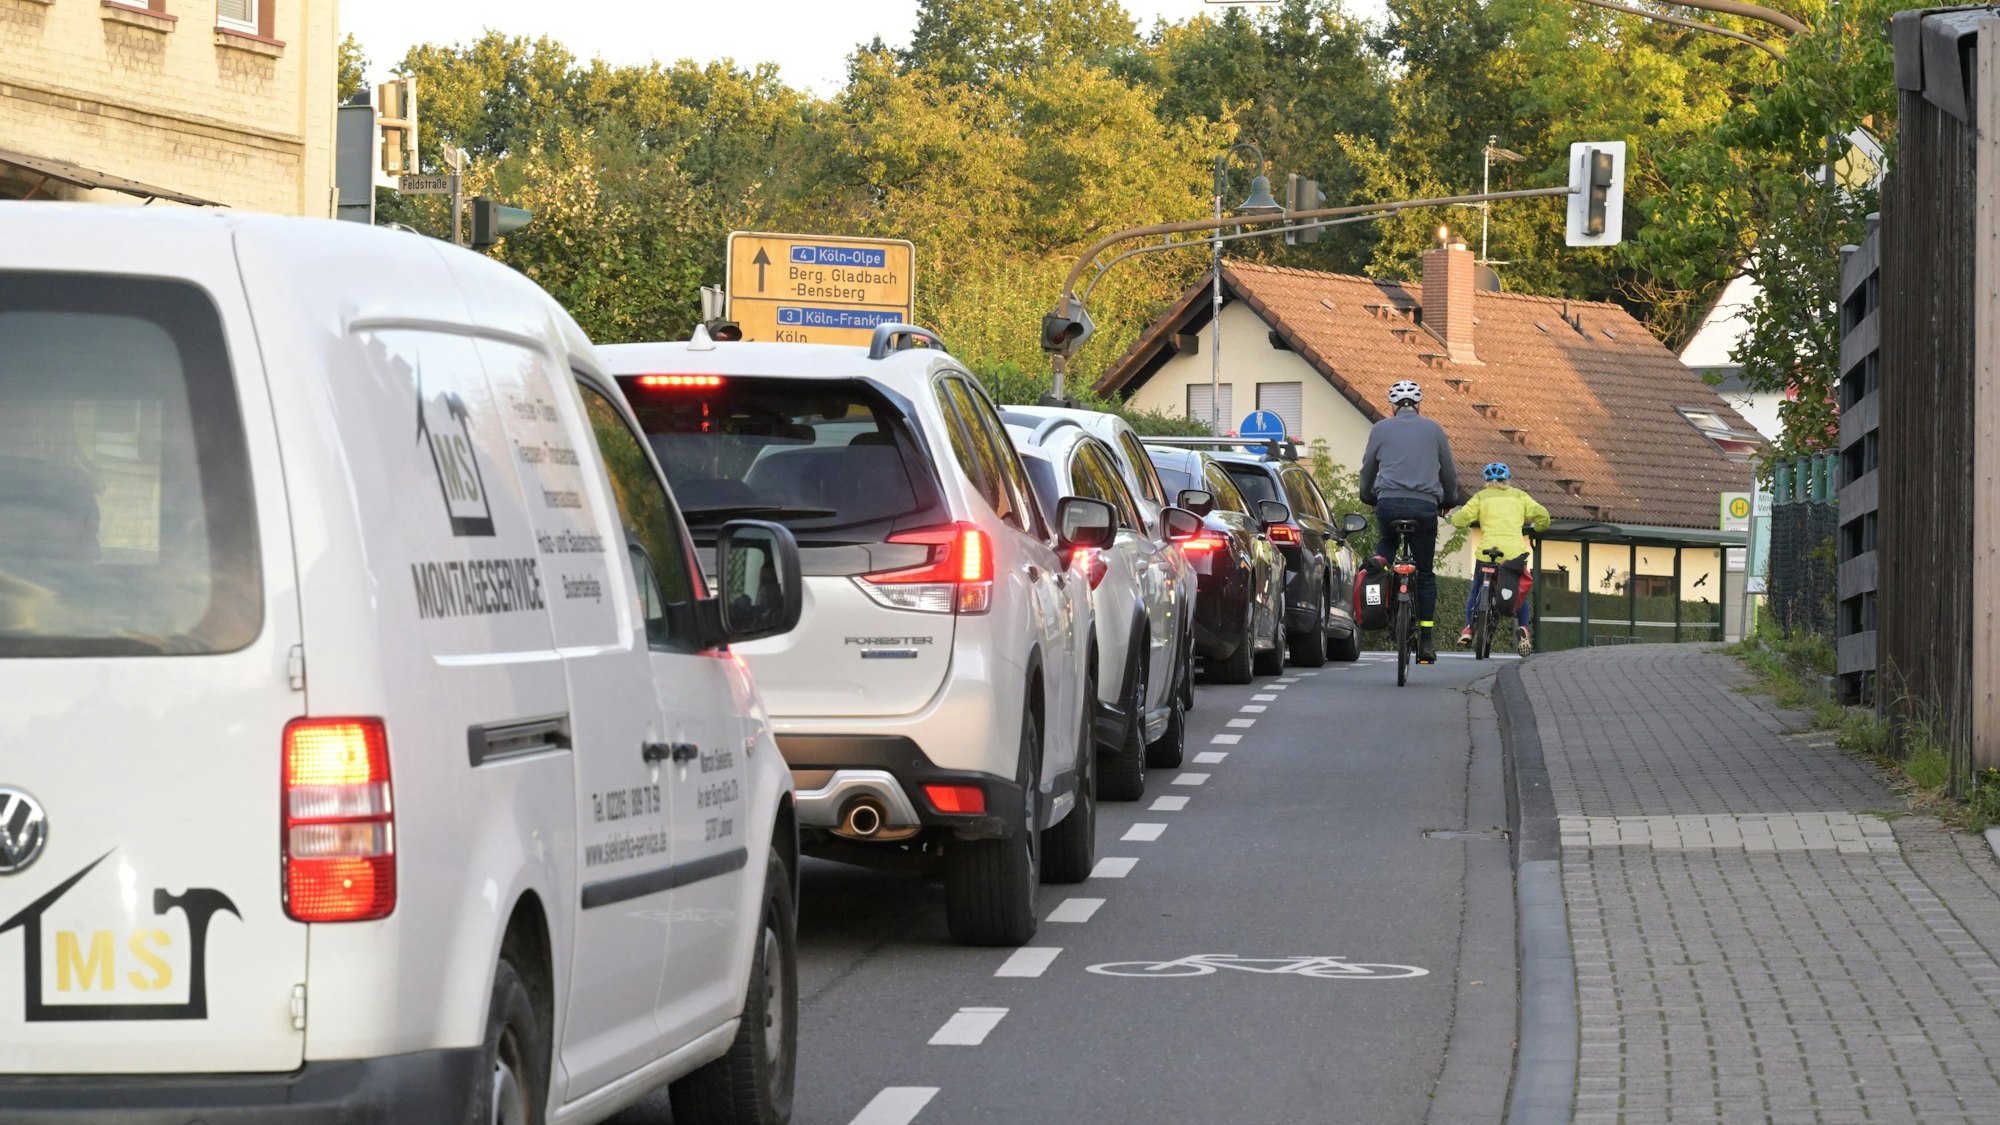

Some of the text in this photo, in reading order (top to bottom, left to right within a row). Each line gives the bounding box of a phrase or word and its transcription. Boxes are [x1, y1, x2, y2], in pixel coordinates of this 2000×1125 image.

[402, 179, 447, 191] Feldstraße
[819, 249, 881, 266] Köln-Olpe
[789, 267, 897, 285] Berg. Gladbach
[790, 283, 866, 301] -Bensberg
[805, 311, 899, 327] Köln-Frankfurt
[775, 330, 808, 343] Köln
[434, 433, 479, 502] MS
[1735, 502, 1745, 514] H
[411, 558, 545, 619] MONTAGESERVICE
[844, 636, 934, 645] FORESTER
